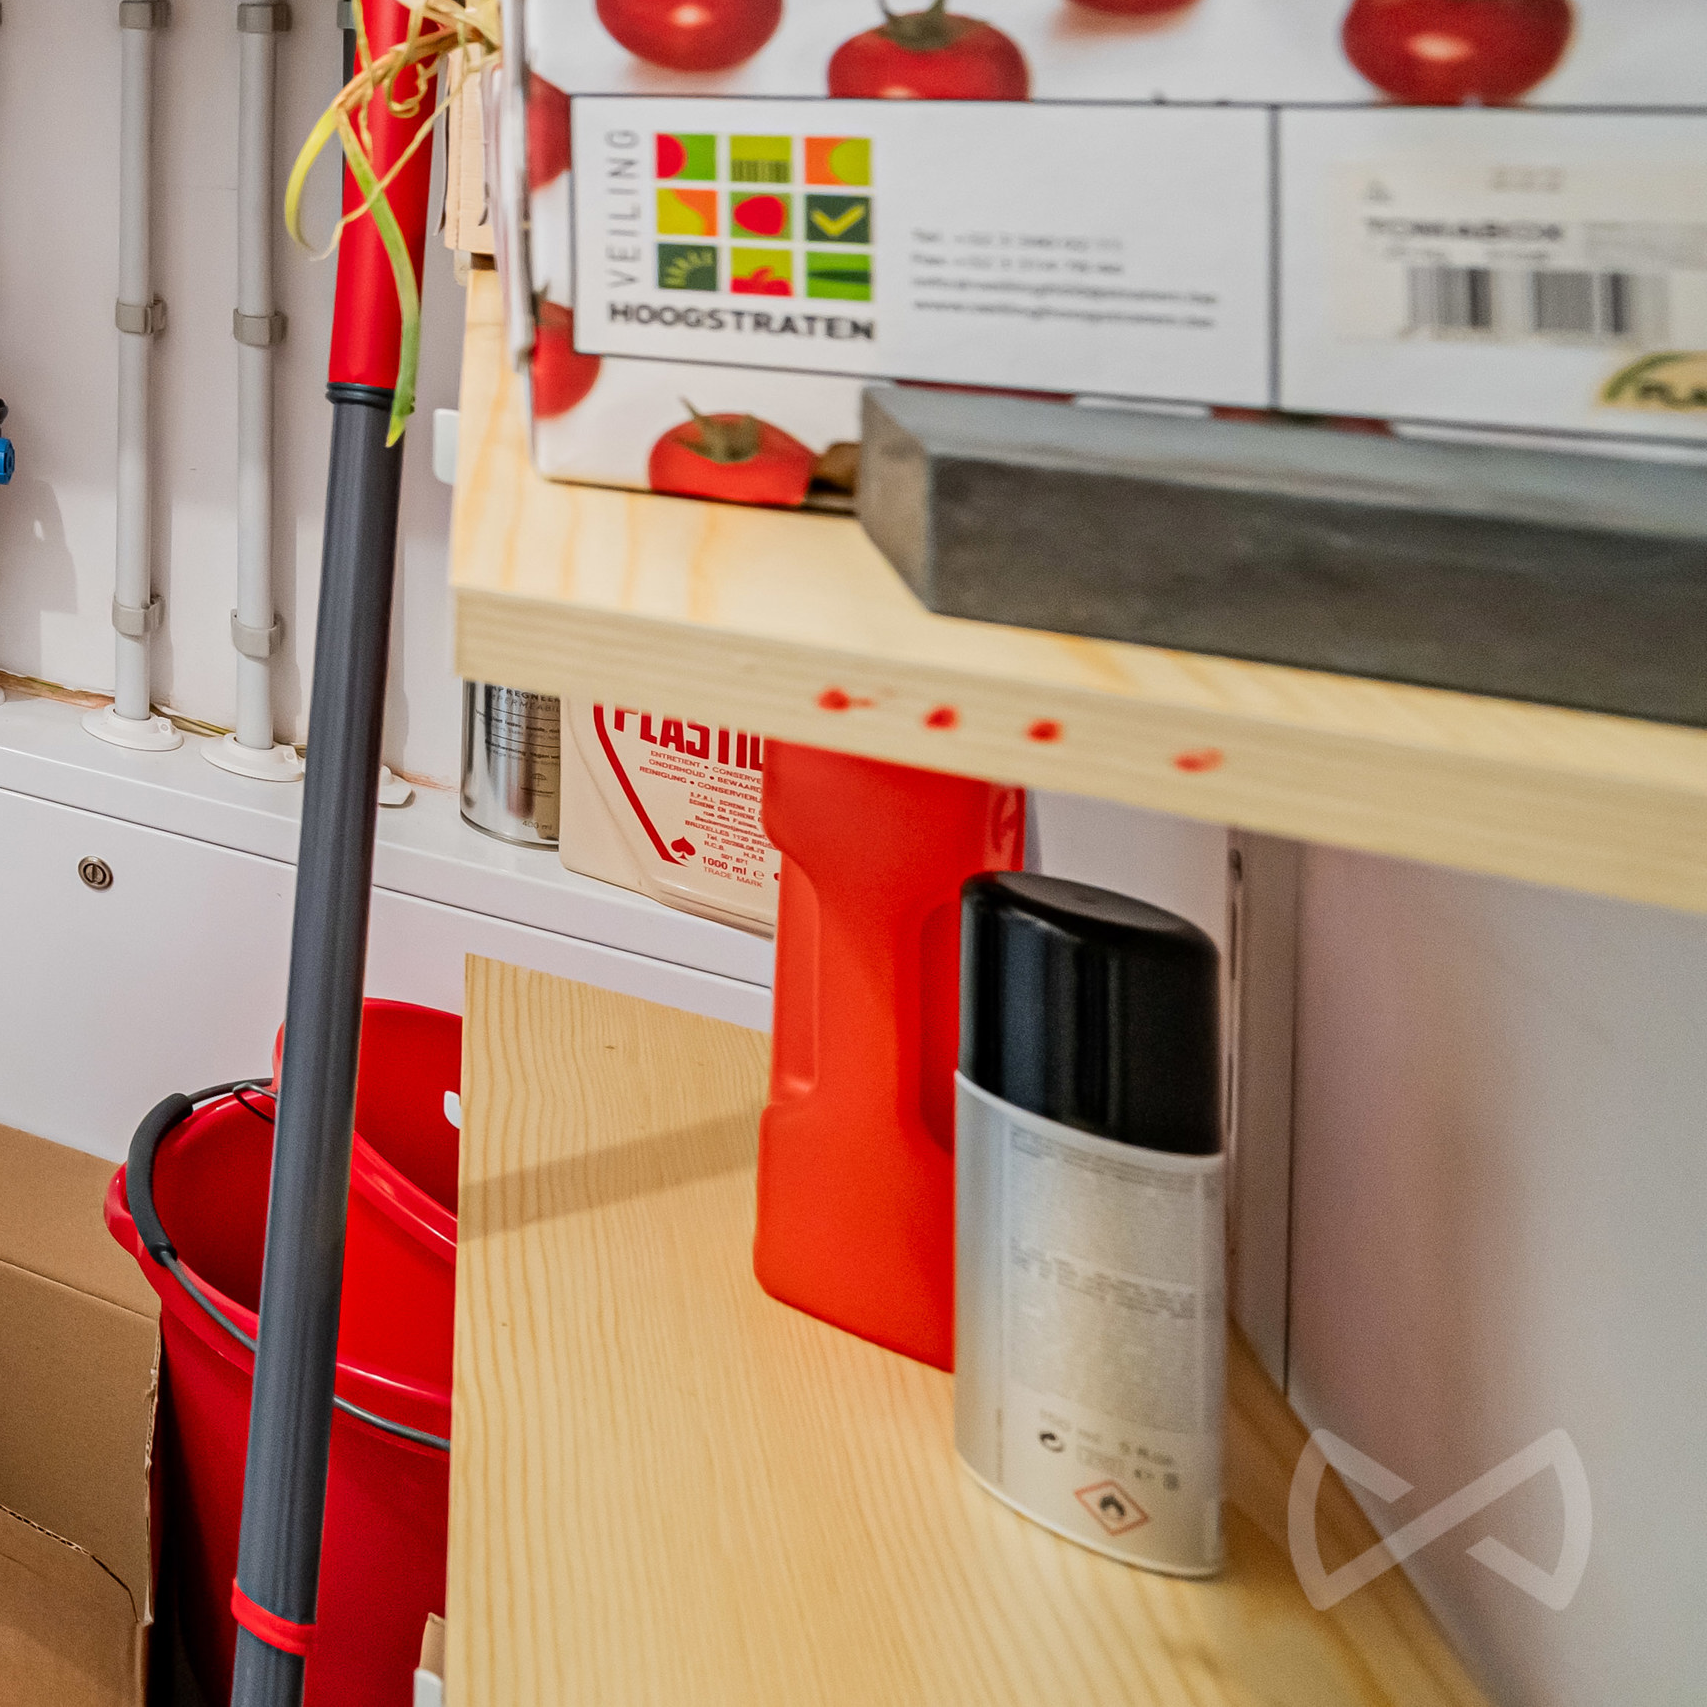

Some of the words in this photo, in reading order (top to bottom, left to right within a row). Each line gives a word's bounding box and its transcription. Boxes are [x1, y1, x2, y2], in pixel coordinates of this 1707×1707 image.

[605, 129, 640, 288] VEILING
[608, 302, 875, 341] HOOGSTRATEN
[648, 758, 706, 778] ONDERHOUD
[650, 750, 701, 768] ENTRETIENT
[639, 766, 687, 784] REINIGUNG
[689, 798, 715, 810] SCHENK
[729, 809, 755, 821] SCHENK
[719, 799, 746, 812] SCHENK
[522, 820, 540, 829] 400
[542, 823, 553, 831] ml
[685, 819, 730, 838] BRUXELLES
[702, 856, 728, 871] 1000
[732, 865, 747, 876] ml
[704, 866, 732, 880] TRADE
[736, 876, 763, 888] MARK
